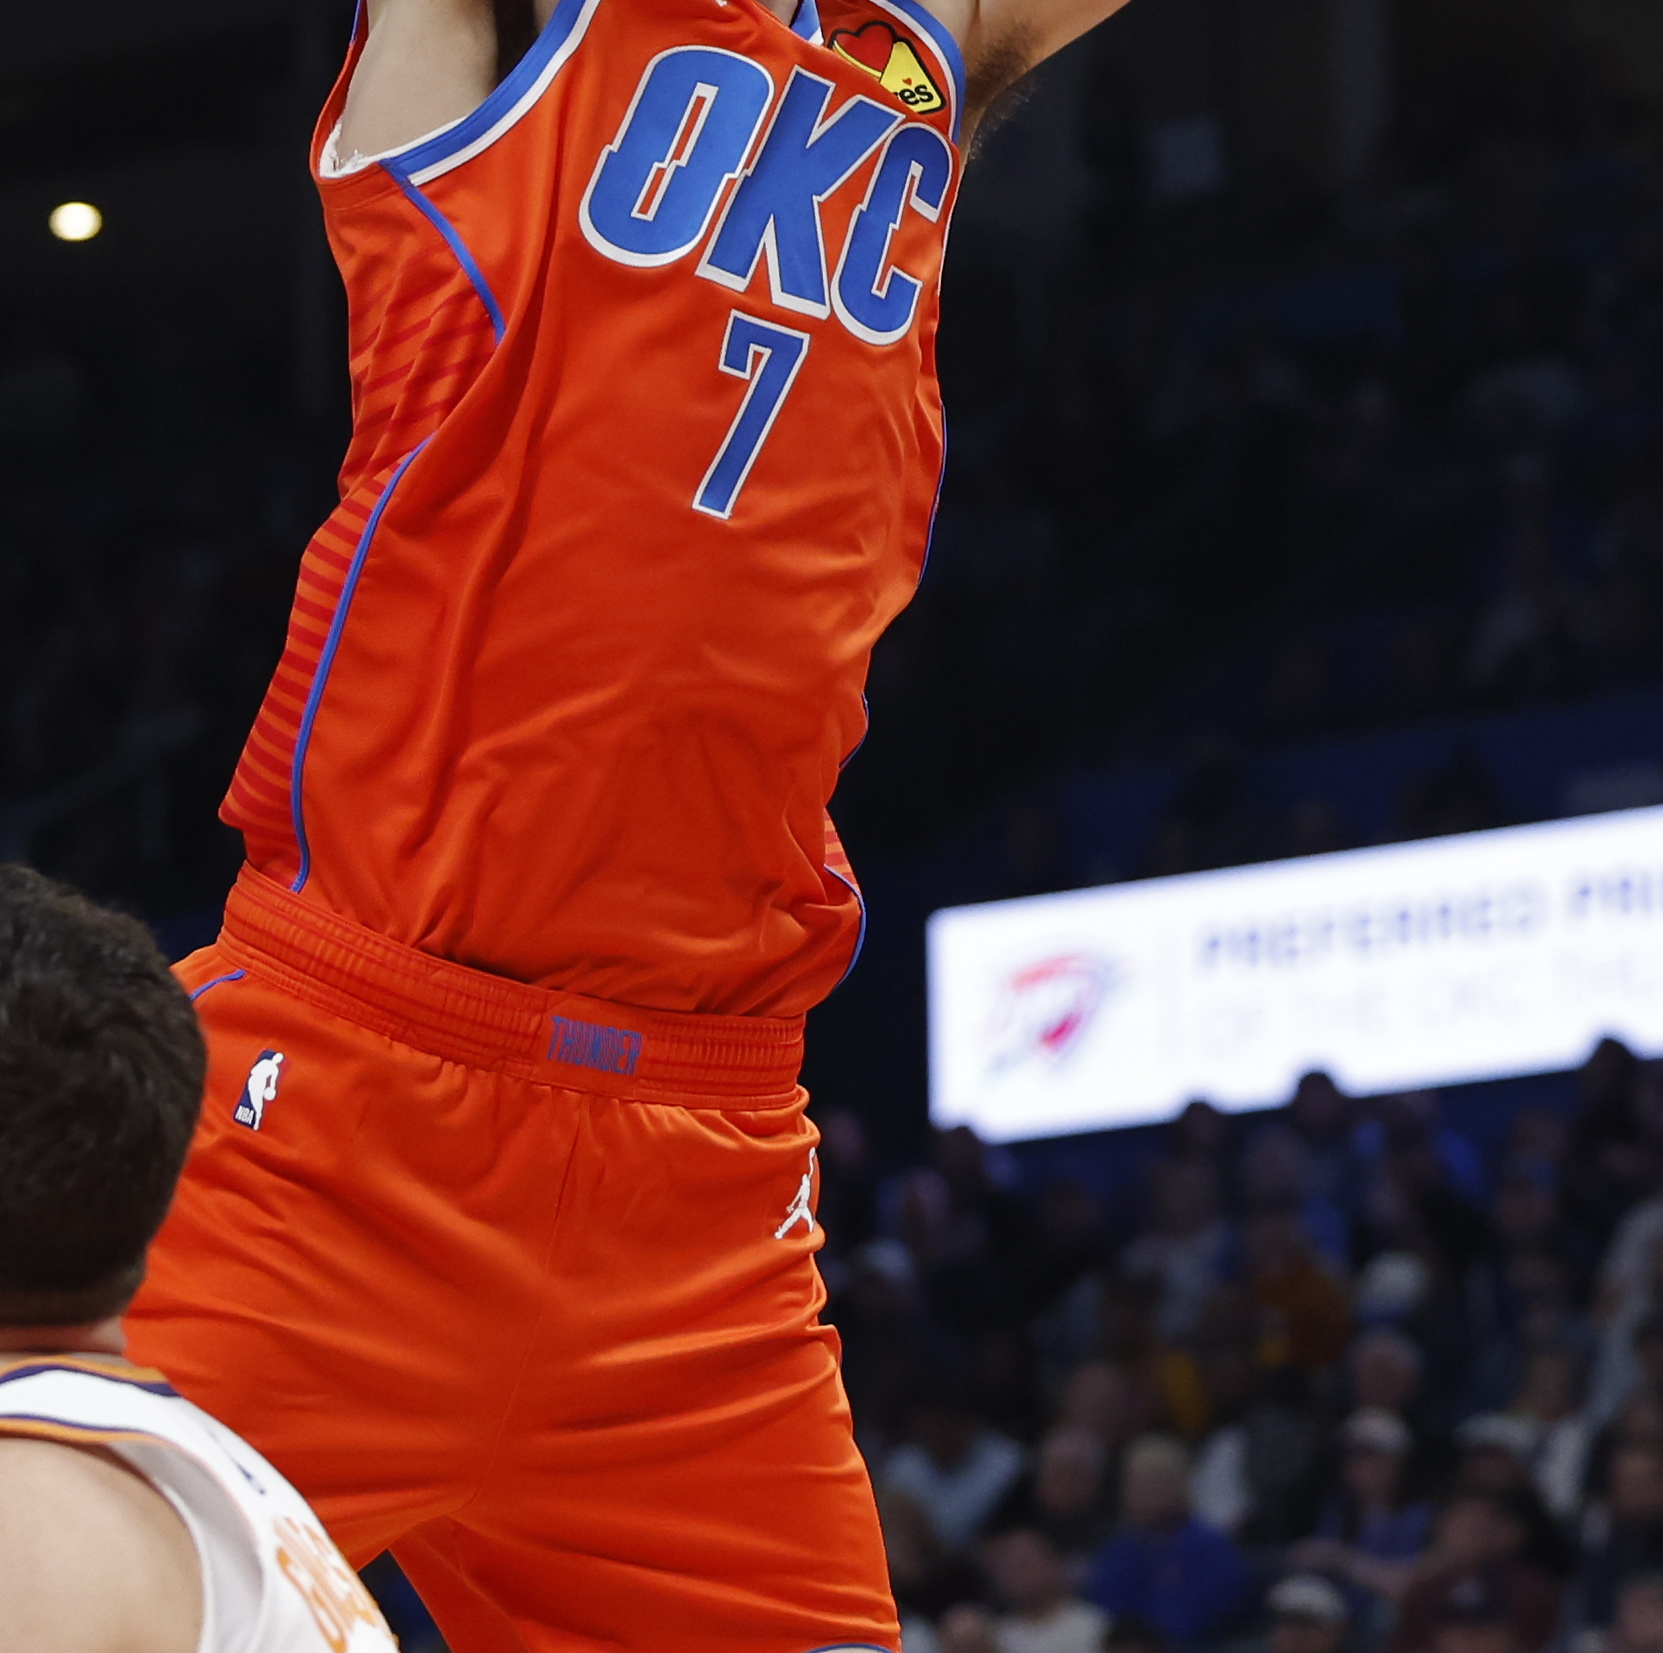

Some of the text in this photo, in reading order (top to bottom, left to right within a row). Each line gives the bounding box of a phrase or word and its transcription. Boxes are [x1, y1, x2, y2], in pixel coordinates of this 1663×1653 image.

[578, 44, 953, 346] OKC
[691, 308, 811, 520] 7
[546, 1015, 642, 1076] THUNDER
[234, 1104, 256, 1125] NBA
